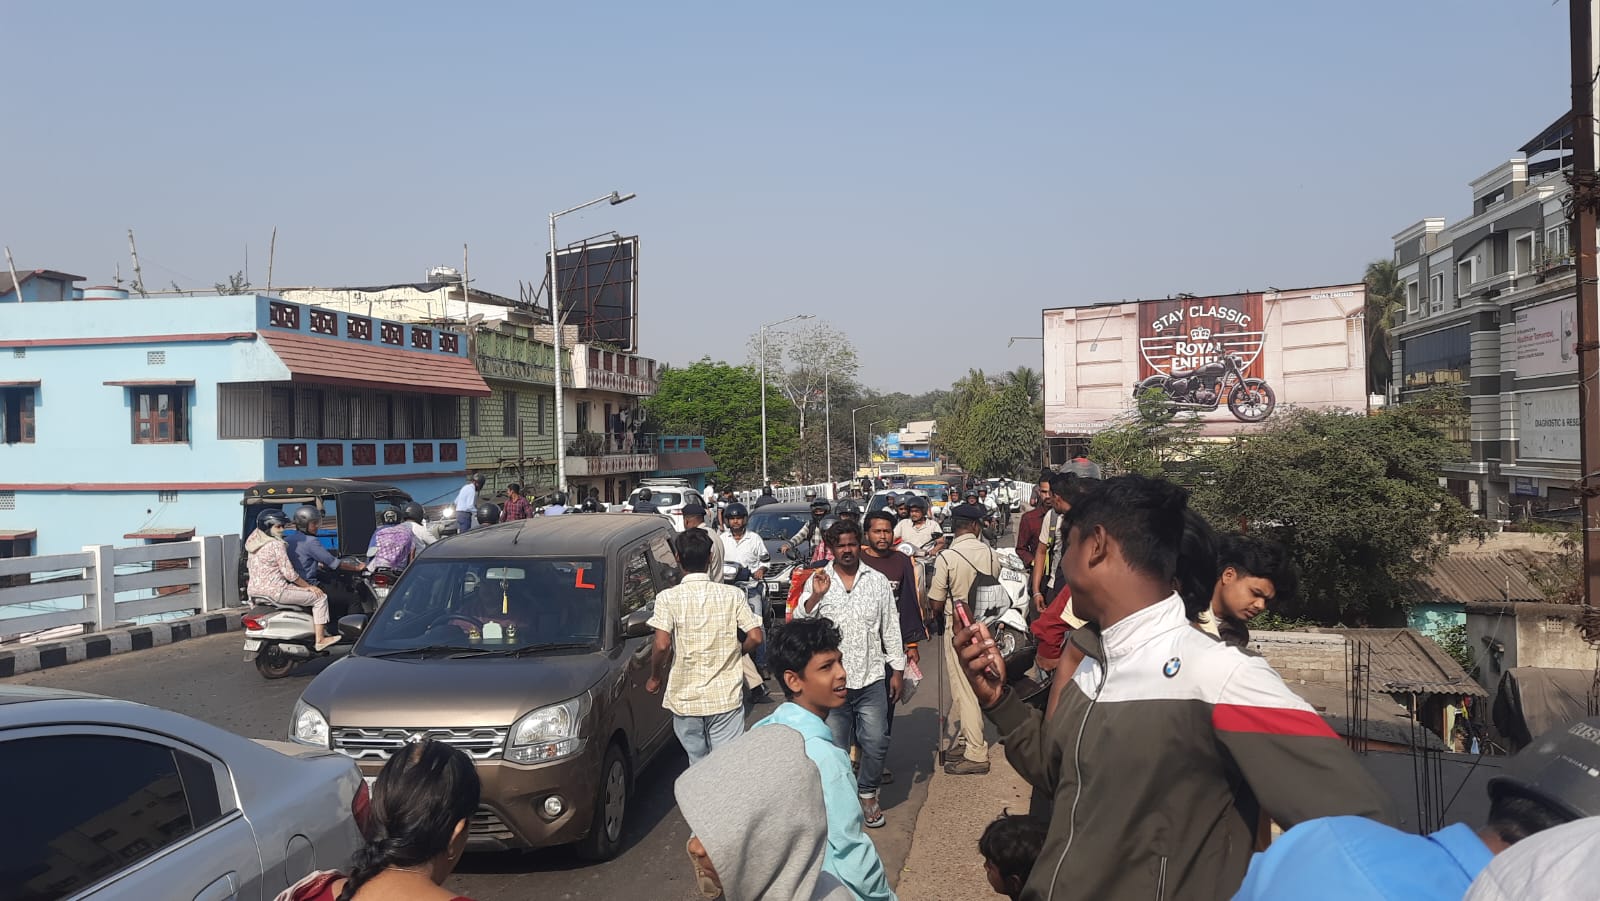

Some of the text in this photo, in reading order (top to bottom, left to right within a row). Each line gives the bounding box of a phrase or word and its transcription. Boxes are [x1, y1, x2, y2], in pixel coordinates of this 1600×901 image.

[1152, 305, 1251, 332] STAY CLASSIC
[1535, 418, 1561, 427] DIAGNOSTIC
[1562, 418, 1566, 427] &
[575, 567, 595, 589] L
